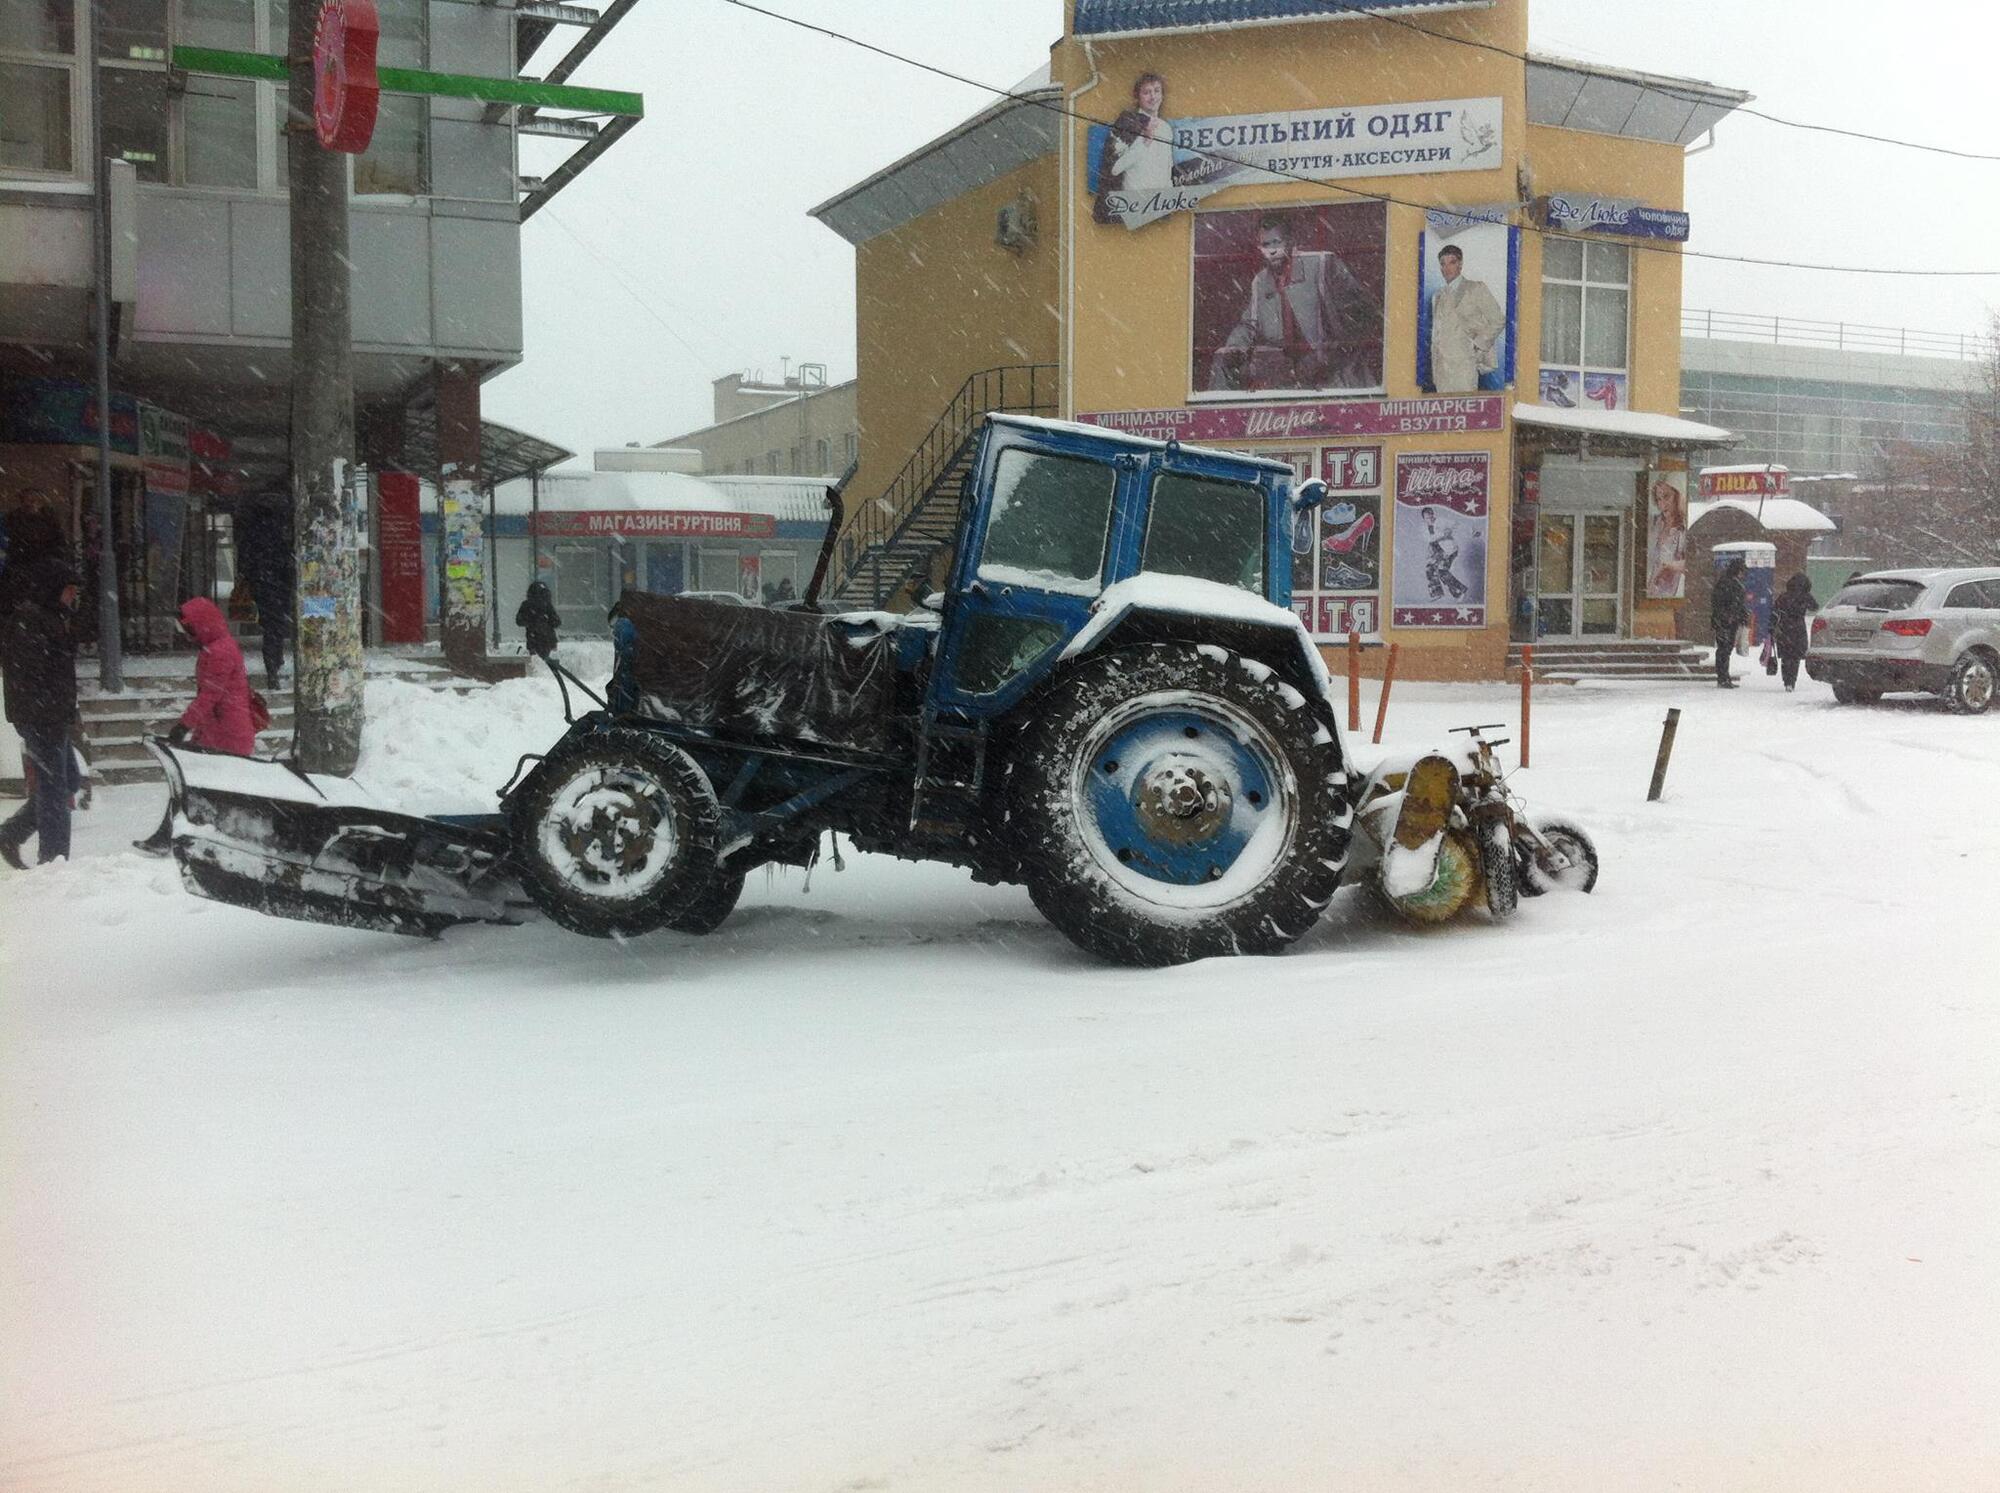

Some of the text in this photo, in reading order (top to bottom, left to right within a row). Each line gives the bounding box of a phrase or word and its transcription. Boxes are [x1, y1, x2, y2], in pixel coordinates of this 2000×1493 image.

[1178, 111, 1452, 149] ВЕСІЛЬНИЙ ОДЯГ
[1106, 194, 1137, 216] Де
[1380, 399, 1488, 417] МІНІМАРКЕТ
[1096, 411, 1197, 427] МІНІМАРКЕТ
[1401, 415, 1468, 432] ВЗУТТЯ
[589, 515, 742, 532] МАГАЗИН-ГУРТІВНЯ
